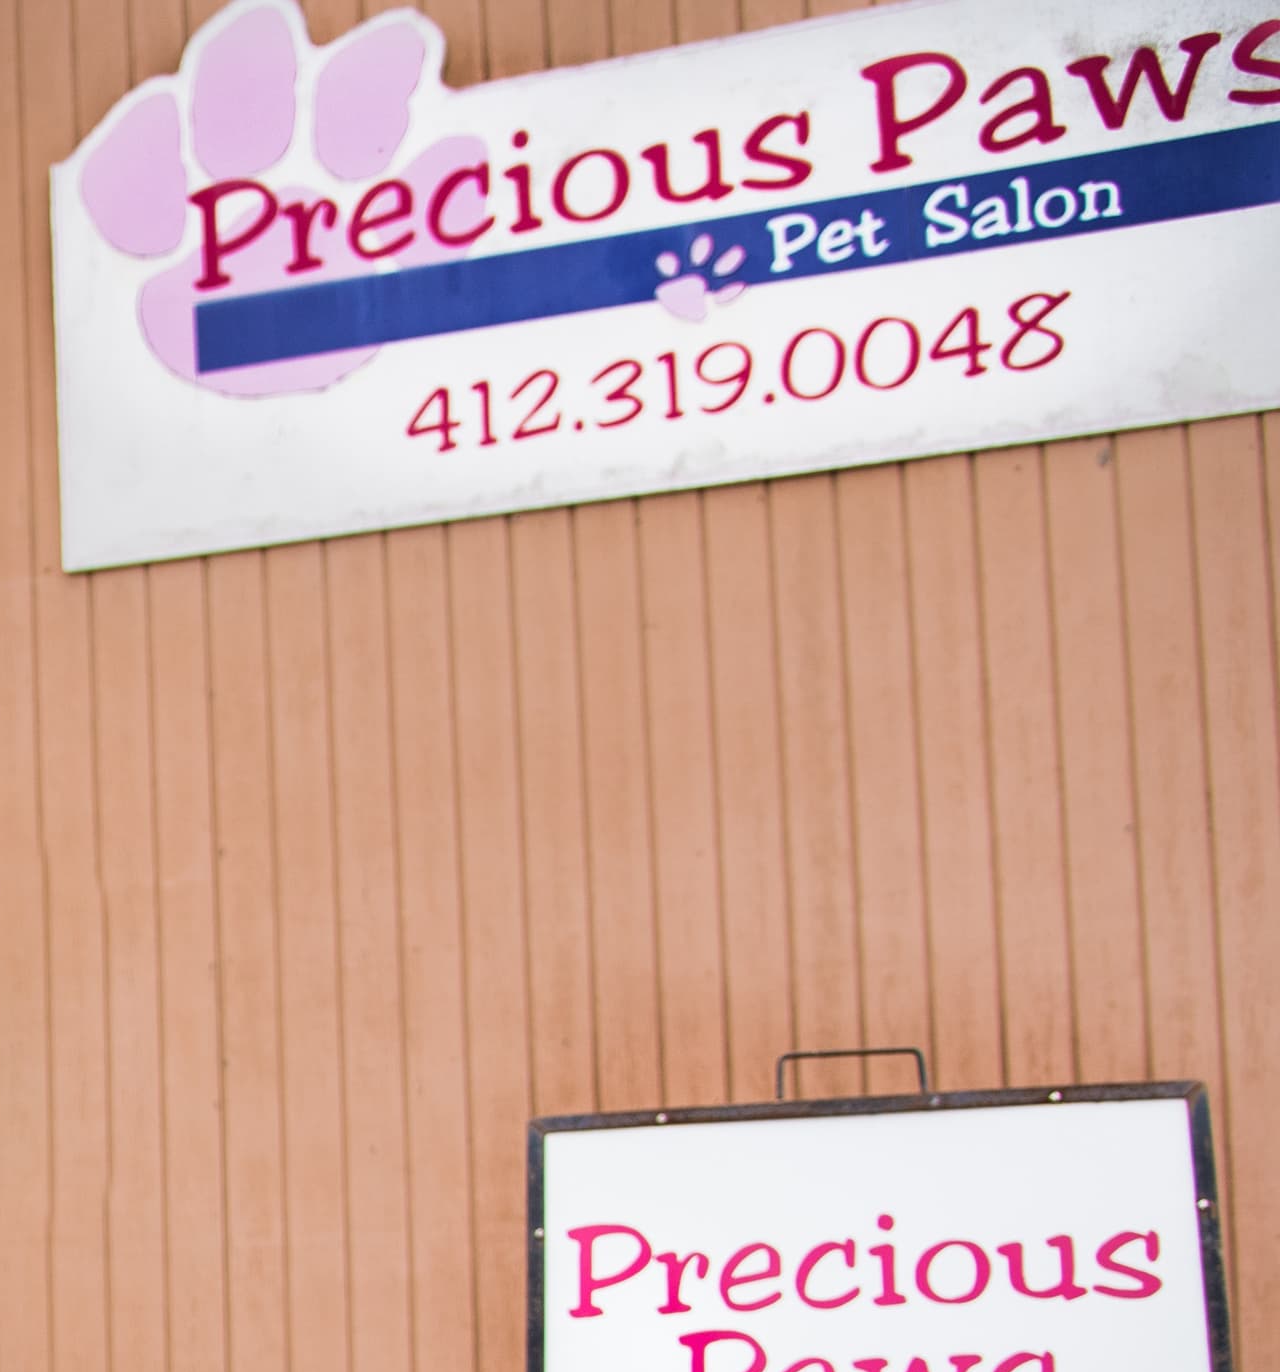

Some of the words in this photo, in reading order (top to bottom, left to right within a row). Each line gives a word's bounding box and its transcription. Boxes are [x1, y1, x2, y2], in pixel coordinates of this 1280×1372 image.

[186, 110, 814, 292] Precious
[860, 18, 1280, 175] Paws
[766, 211, 888, 273] Pet
[923, 177, 1124, 248] Salon
[405, 290, 1071, 454] 412.319.0048
[566, 1214, 1164, 1319] Precious
